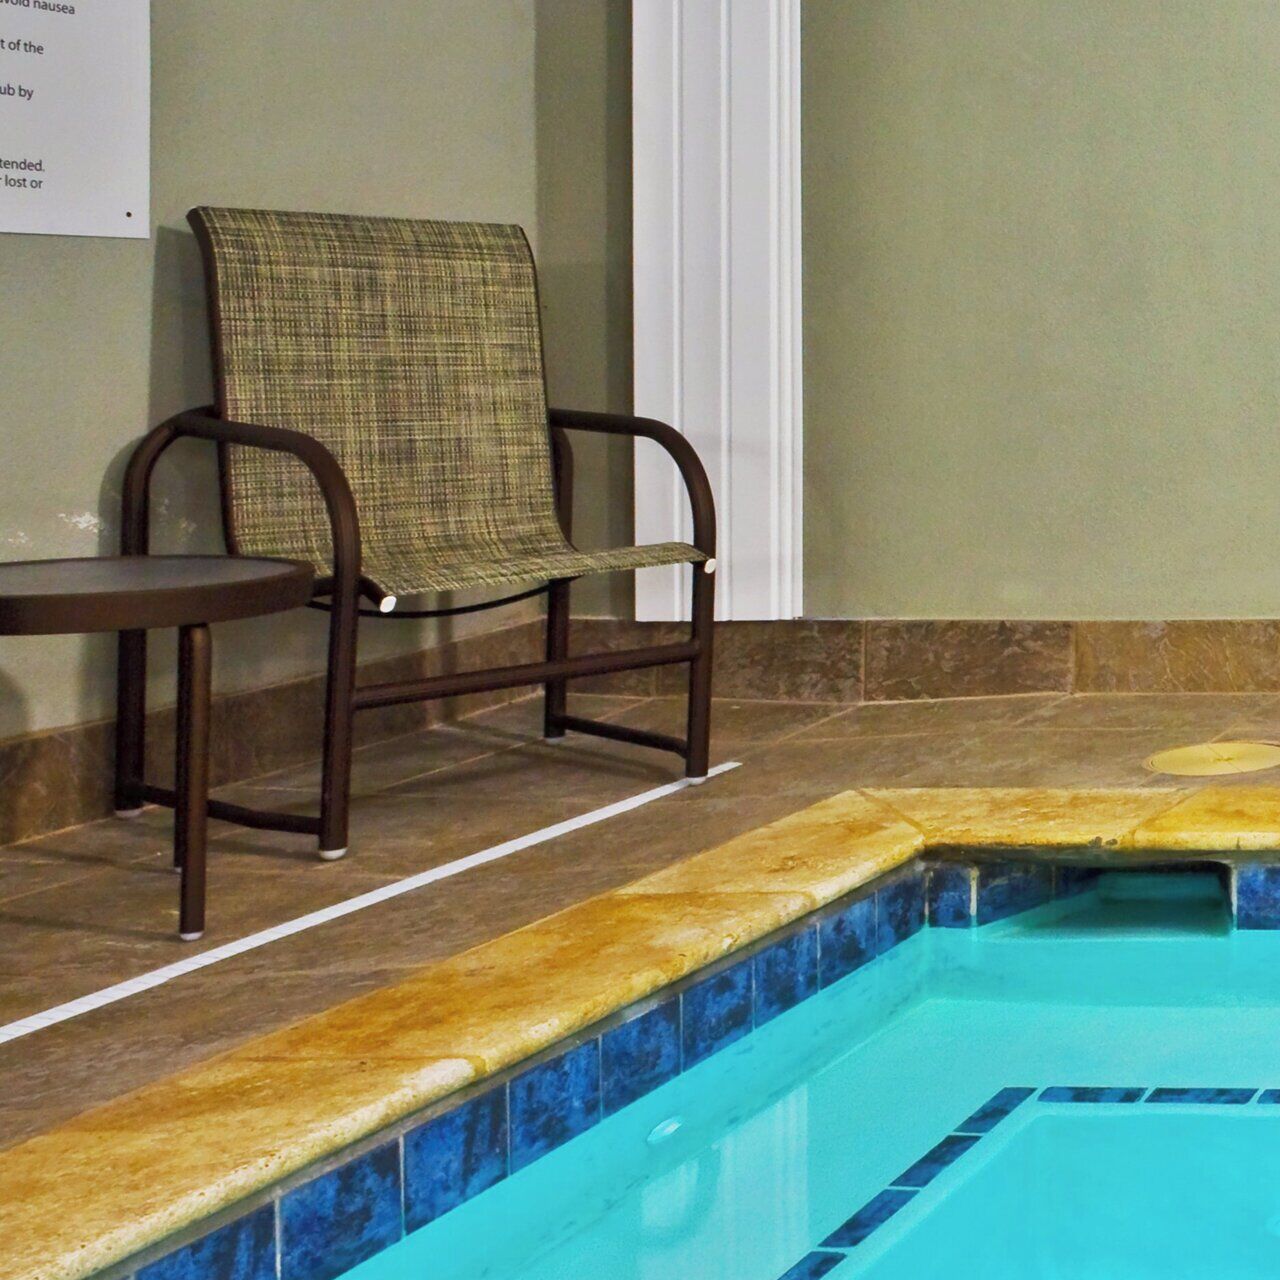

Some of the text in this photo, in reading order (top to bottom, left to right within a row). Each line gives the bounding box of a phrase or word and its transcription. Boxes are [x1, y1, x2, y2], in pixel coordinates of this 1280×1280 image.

[0, 0, 76, 15] oid nausea
[8, 39, 21, 51] of
[23, 41, 45, 55] the
[18, 85, 34, 101] by
[5, 174, 28, 188] lost
[30, 179, 44, 189] or
